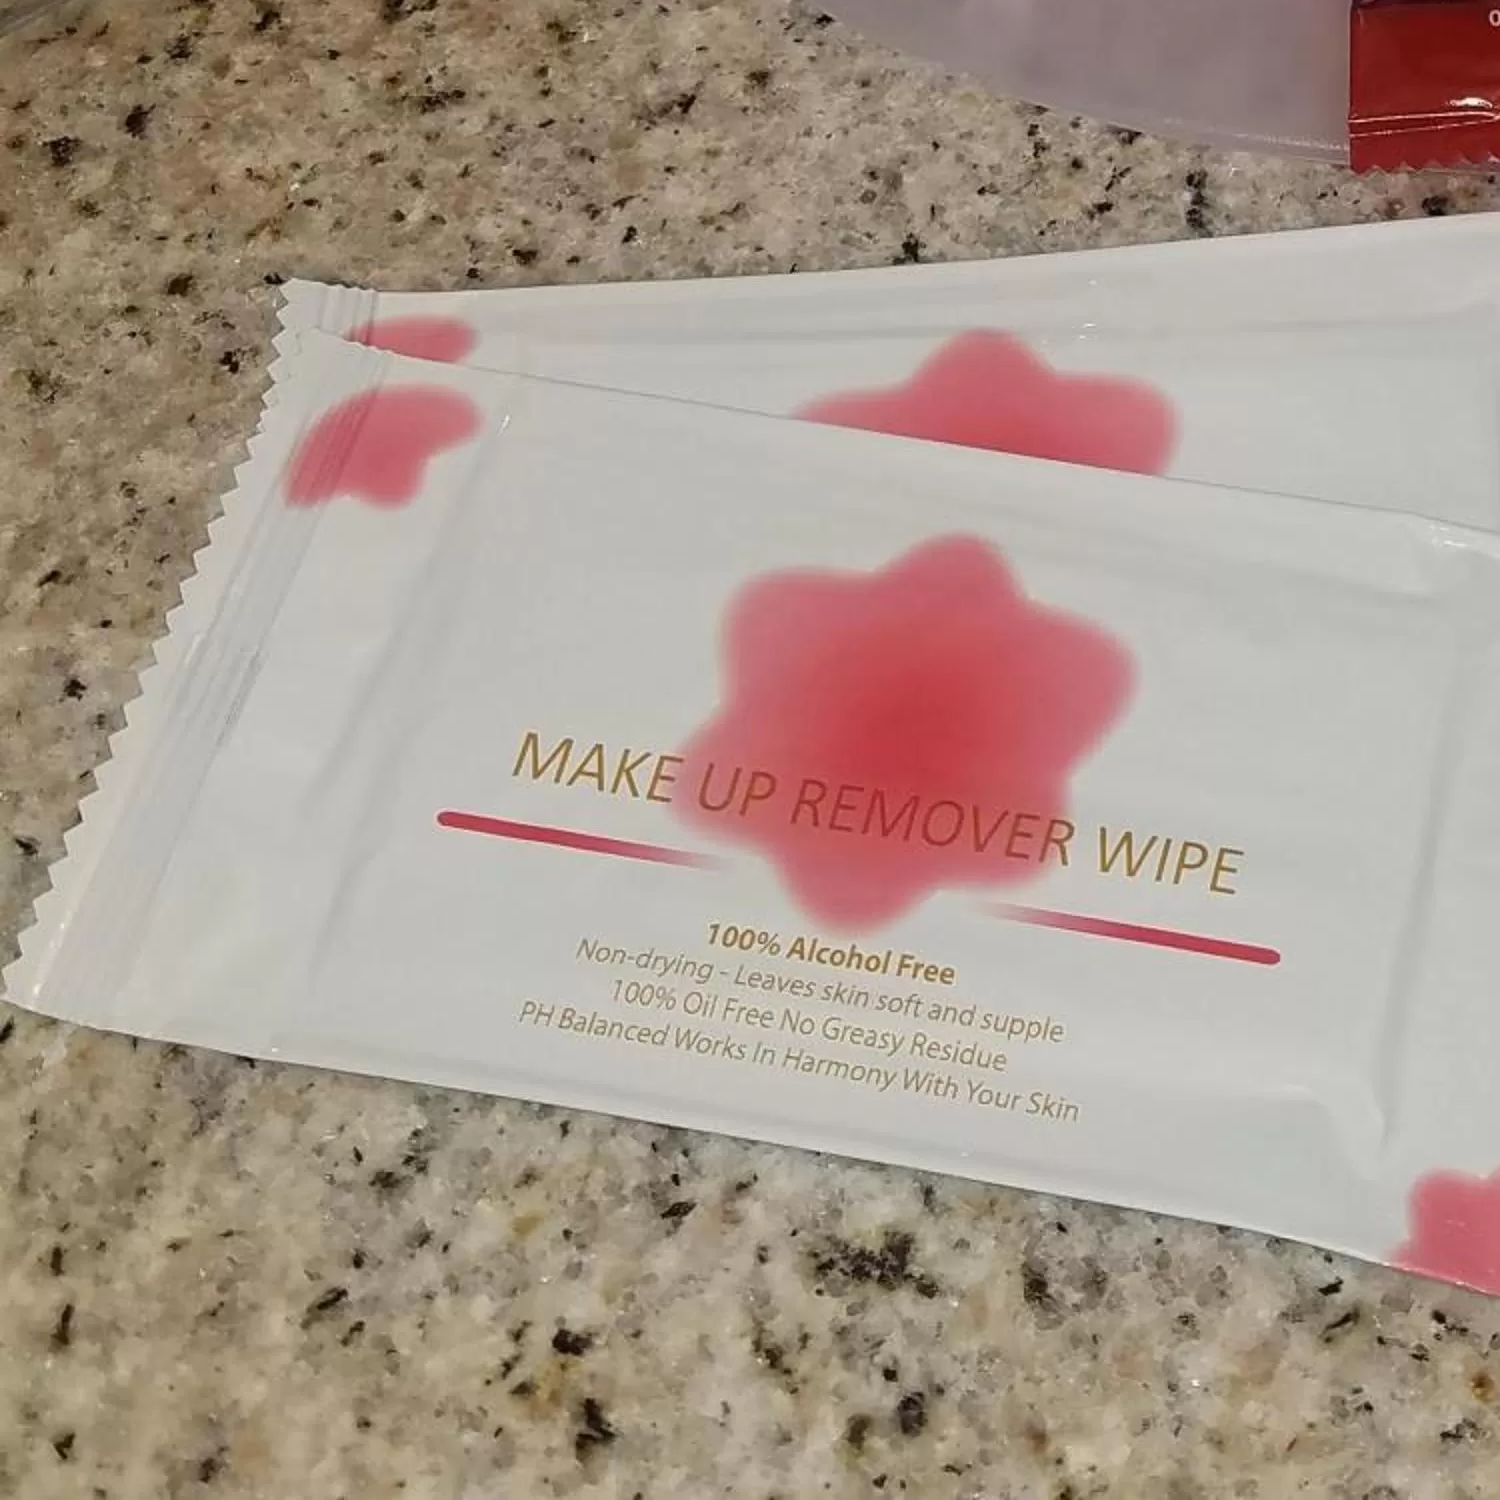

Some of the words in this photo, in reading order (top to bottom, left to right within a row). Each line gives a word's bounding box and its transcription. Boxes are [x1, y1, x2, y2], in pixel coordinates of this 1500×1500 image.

[511, 731, 685, 803] MAKE
[698, 761, 777, 817] UP
[788, 778, 1075, 868] REMOVER
[1097, 825, 1246, 896] WIPE
[575, 937, 714, 985] Non-drying
[734, 964, 816, 998] Leaves
[820, 980, 870, 1008] skin
[875, 992, 924, 1019] soft
[927, 1004, 977, 1028] and
[980, 1012, 1065, 1043] supple
[707, 923, 781, 956] 100%
[785, 936, 893, 975] Alcohol
[896, 953, 956, 985] Free
[519, 1000, 555, 1028] PH
[558, 1006, 672, 1047] Balanced
[674, 1026, 747, 1062] Works
[750, 1040, 776, 1066] In
[781, 1047, 898, 1093] Harmony
[902, 1066, 960, 1100] With
[966, 1078, 1023, 1111] Your
[1025, 1090, 1080, 1123] Skin
[612, 979, 677, 1011] 100%
[683, 990, 718, 1019] Oil
[721, 997, 776, 1028] Free
[779, 1008, 816, 1036] No
[821, 1015, 905, 1057] Greasy
[910, 1031, 1008, 1072] Residue
